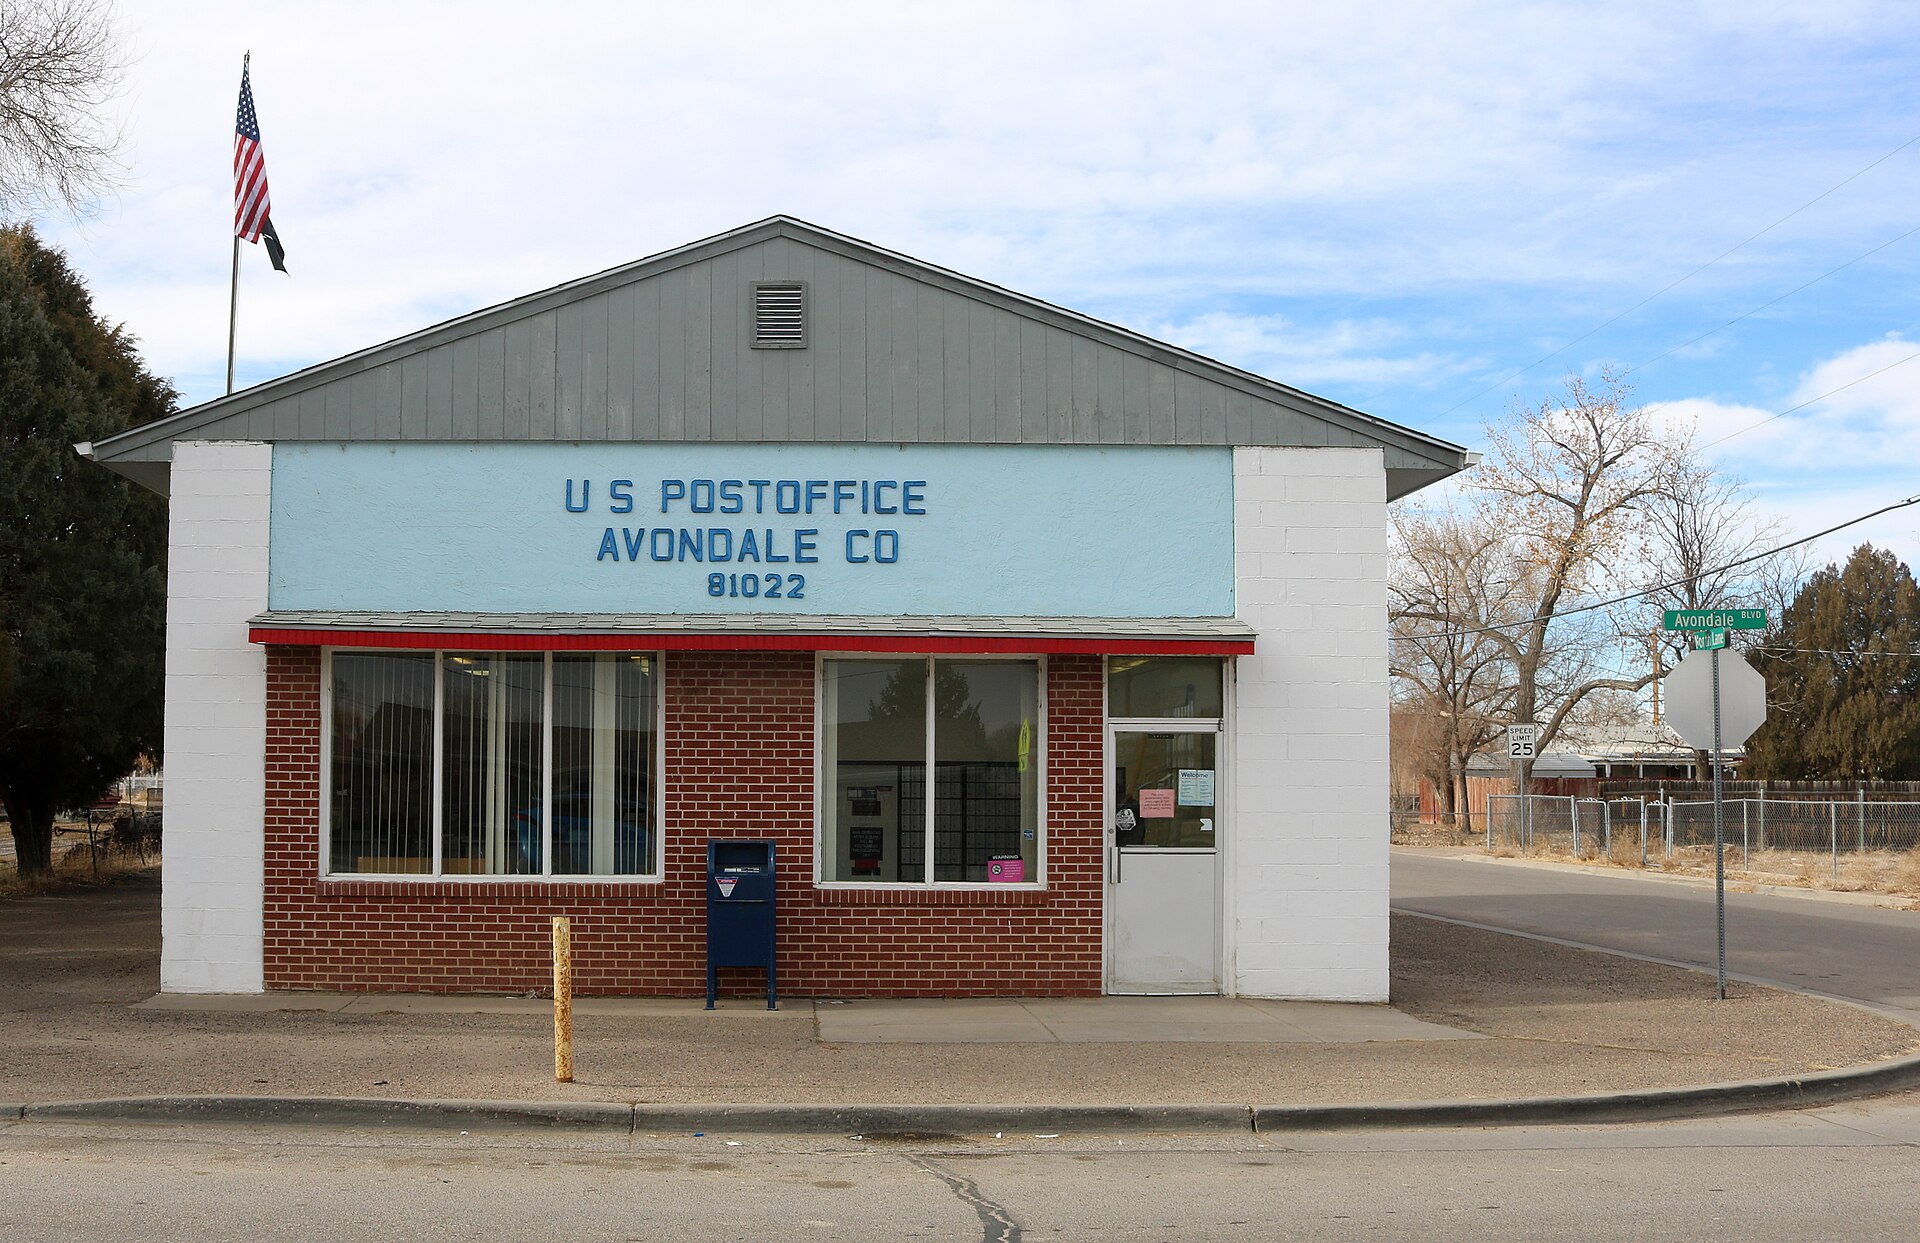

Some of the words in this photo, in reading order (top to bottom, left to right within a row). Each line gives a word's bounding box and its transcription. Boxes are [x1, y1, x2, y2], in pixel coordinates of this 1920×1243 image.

[565, 479, 590, 513] U
[610, 479, 634, 514] S
[661, 479, 927, 515] POSTOFFICE
[597, 528, 819, 564] AVONDALE
[845, 529, 899, 563] CO
[707, 572, 806, 599] 81022
[1674, 613, 1734, 627] Avondale
[1741, 611, 1761, 619] BLVD
[1512, 743, 1533, 756] 25
